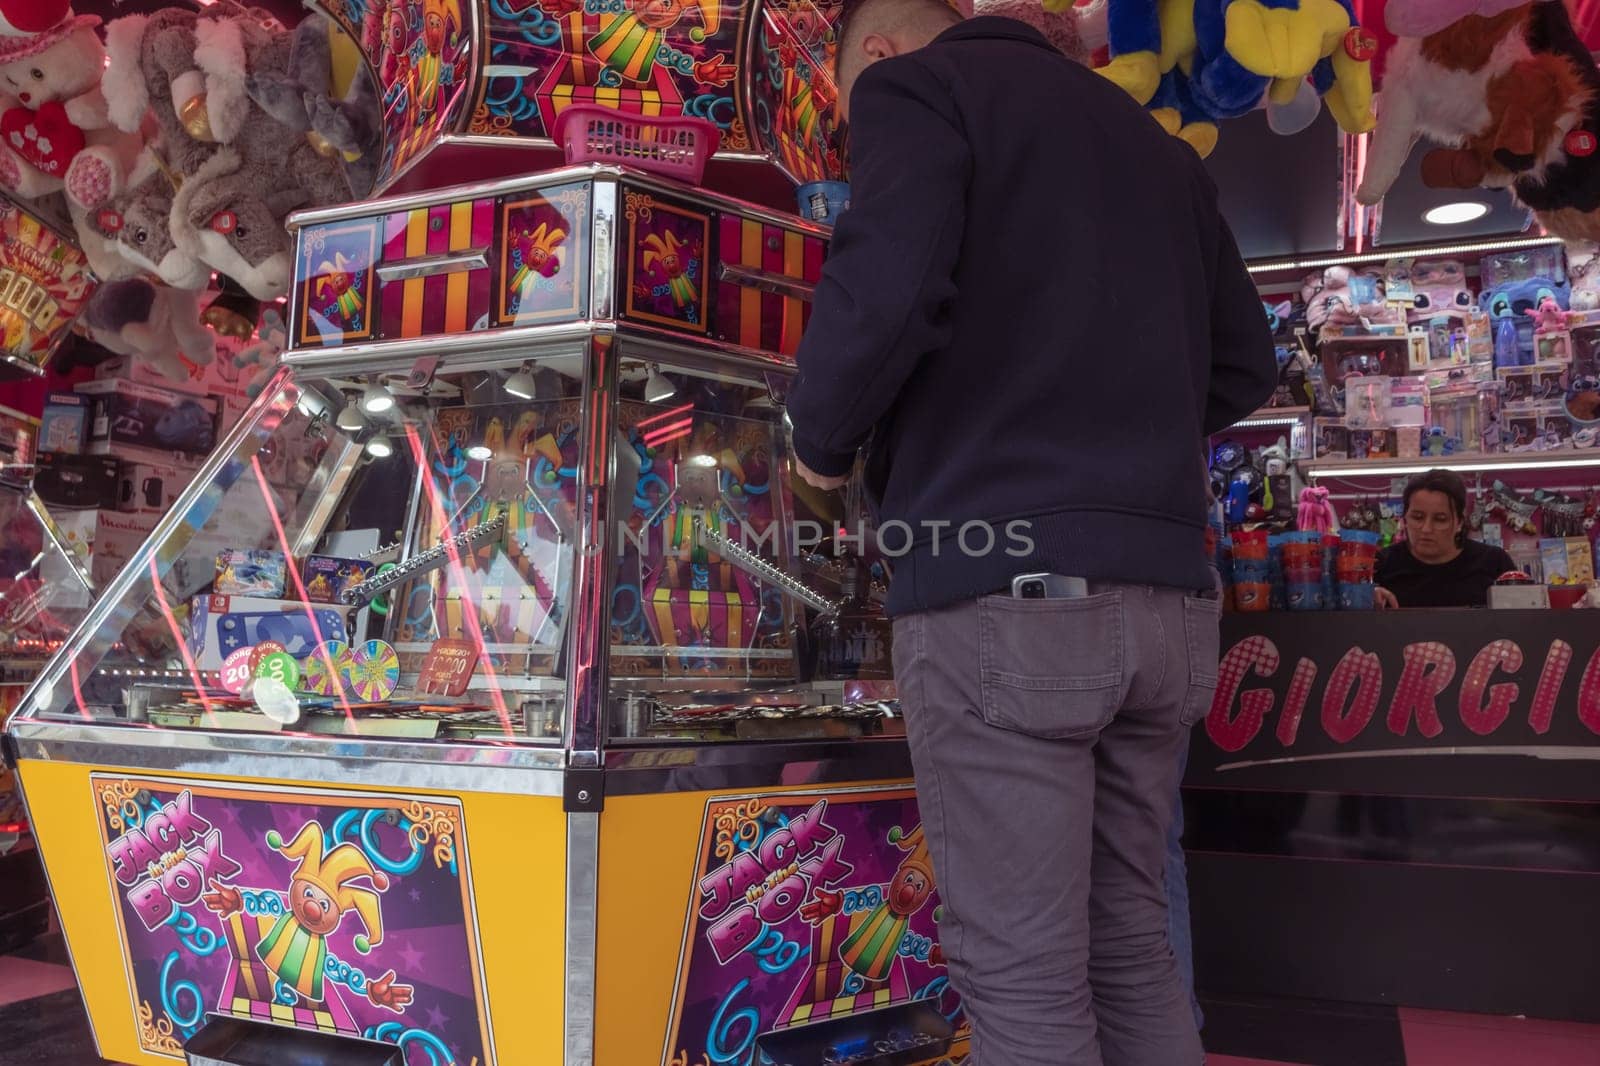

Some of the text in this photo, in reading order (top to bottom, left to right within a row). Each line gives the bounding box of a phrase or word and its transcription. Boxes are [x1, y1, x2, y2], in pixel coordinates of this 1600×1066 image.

[106, 788, 213, 887] JACK
[127, 828, 243, 932] BOX
[699, 798, 838, 921] JACK
[706, 834, 855, 967] BOX
